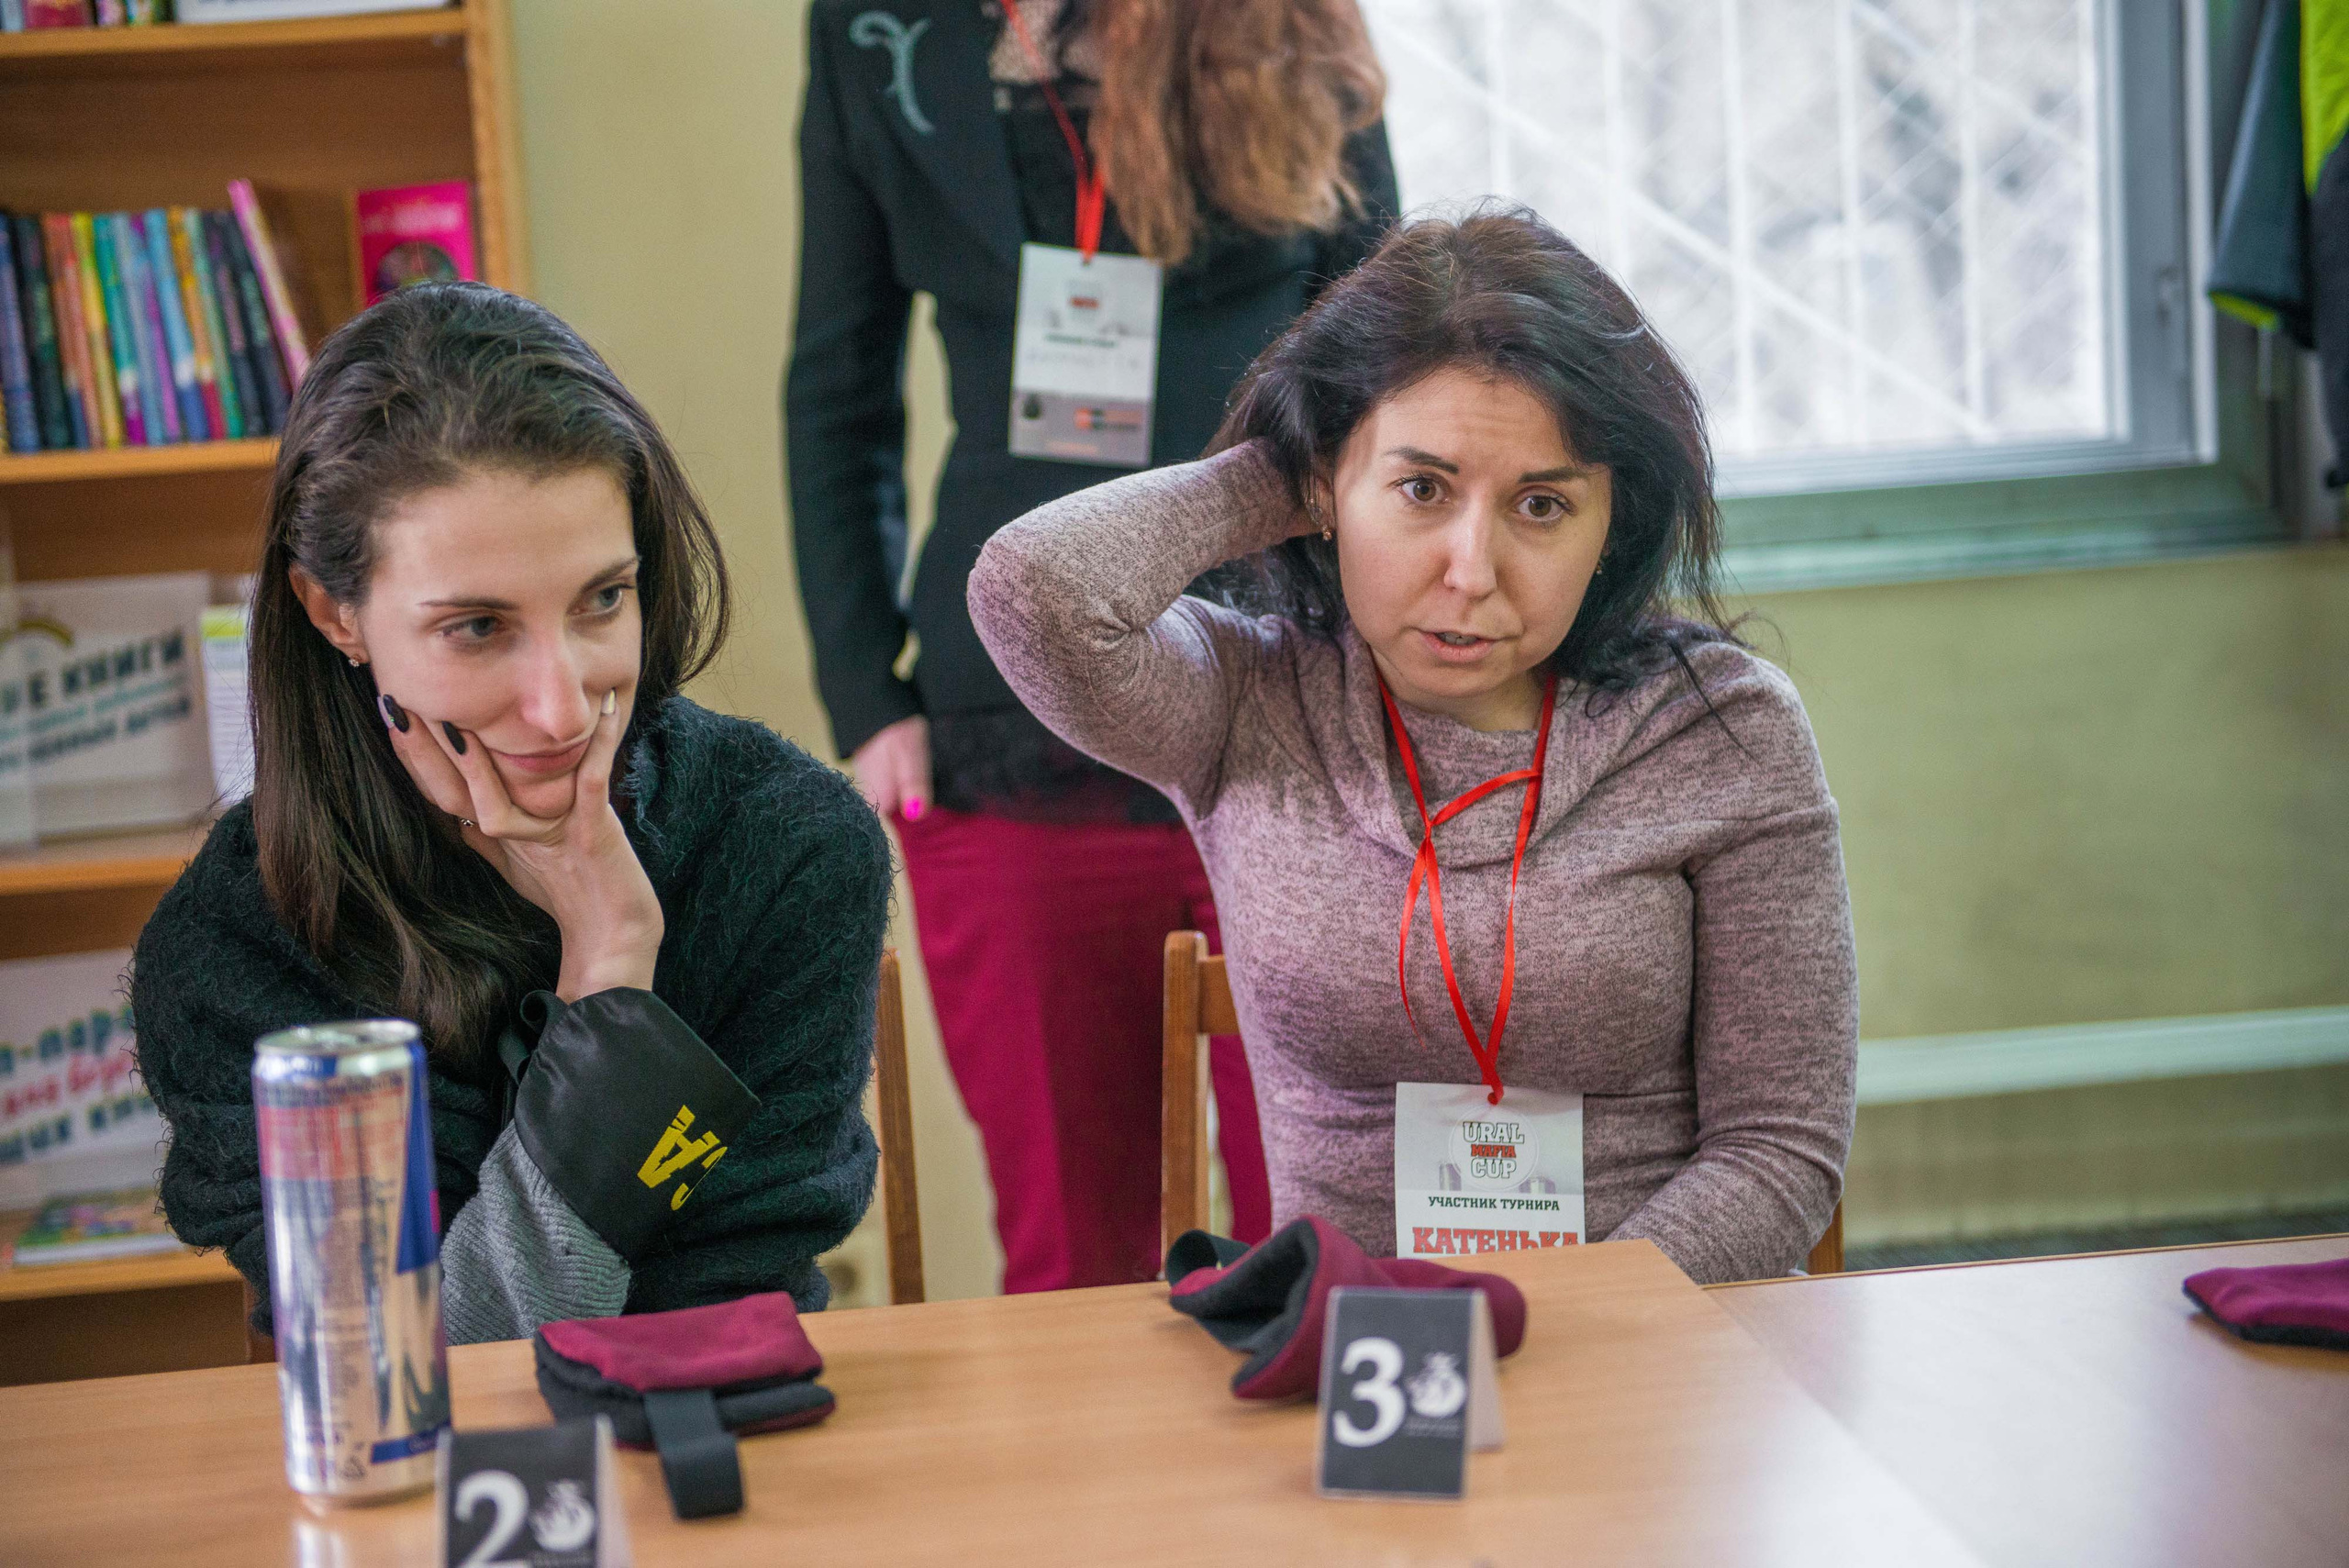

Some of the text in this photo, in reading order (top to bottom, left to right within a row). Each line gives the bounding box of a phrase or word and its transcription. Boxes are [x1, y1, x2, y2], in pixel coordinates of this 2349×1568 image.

[1463, 1121, 1525, 1144] URAL
[1471, 1144, 1517, 1158] MAFIA
[1471, 1157, 1517, 1179] CUP
[1428, 1196, 1560, 1211] УЧАСТНИК ТУРНИРА
[1333, 1336, 1406, 1448] 3
[455, 1470, 533, 1568] 2
